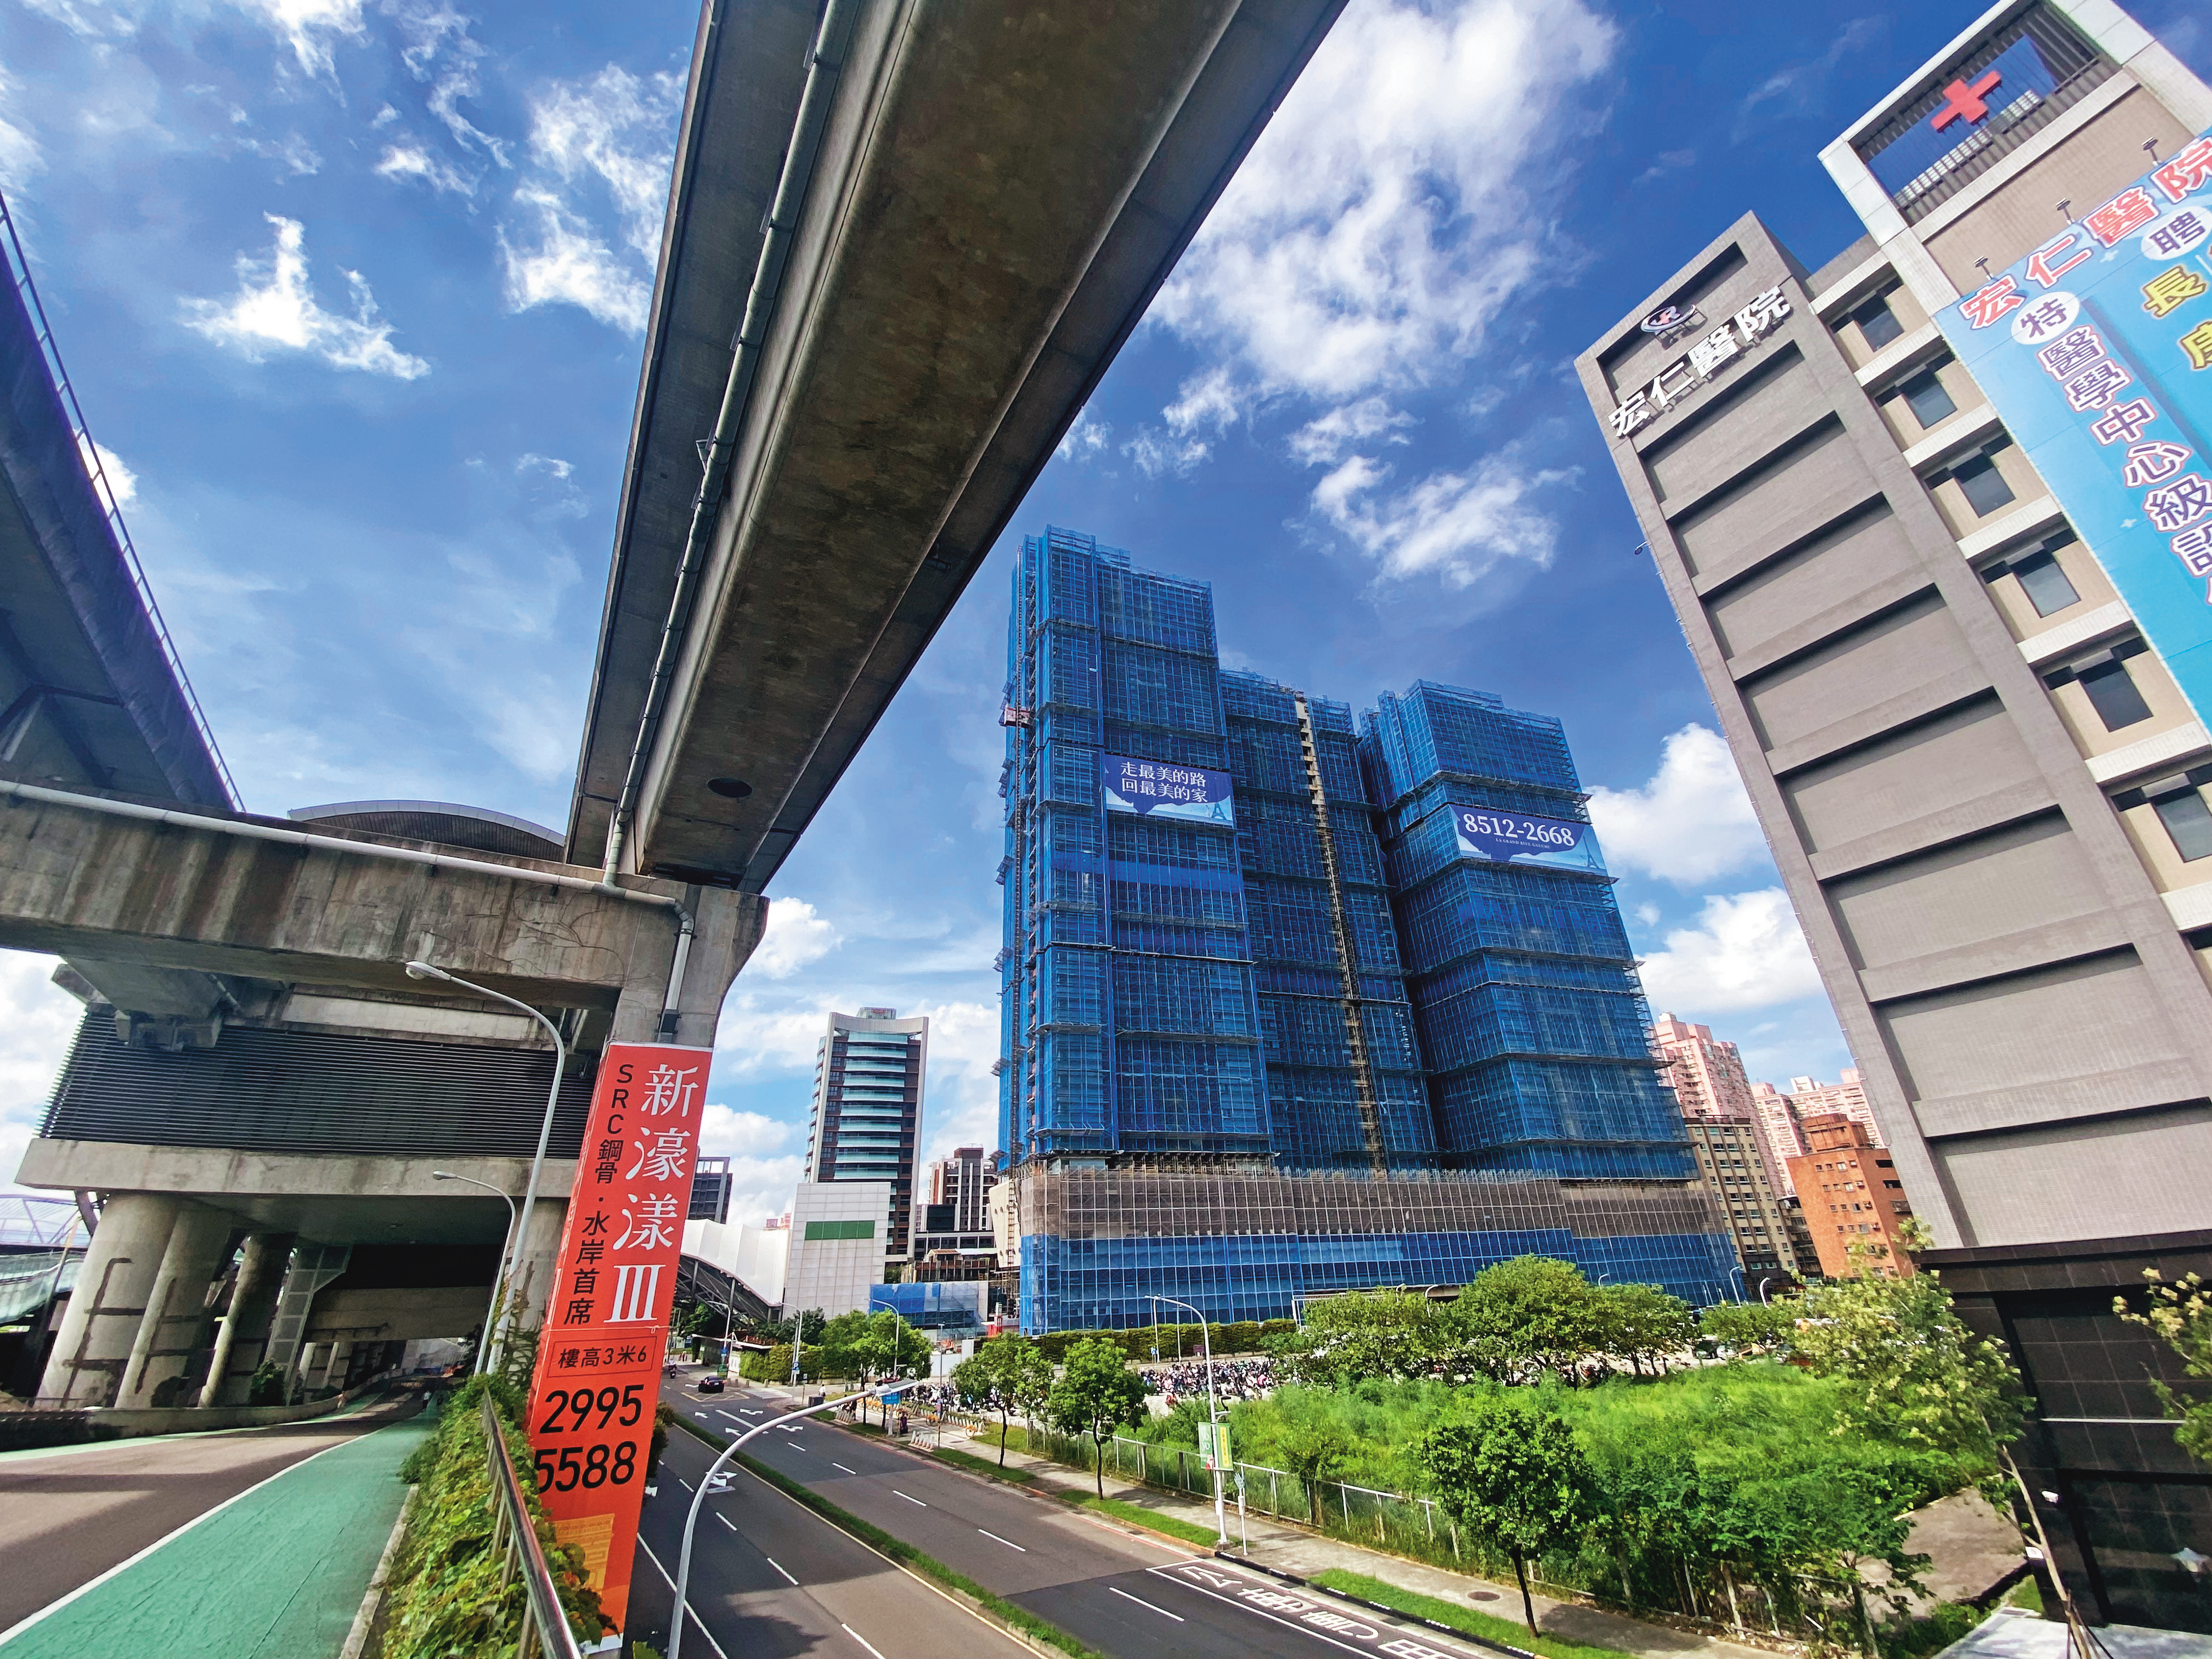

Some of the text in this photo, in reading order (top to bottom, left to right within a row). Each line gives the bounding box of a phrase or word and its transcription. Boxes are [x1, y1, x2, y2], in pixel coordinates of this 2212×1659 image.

[1960, 137, 2212, 329] 宏仁醫院
[1608, 285, 1791, 437] 宏仁醫院
[1120, 761, 1206, 788] 走最美的路
[1121, 778, 1208, 803] 回最美的家
[1463, 813, 1575, 847] 8512-2668
[557, 1345, 647, 1369] 樓高3米6
[540, 1384, 645, 1434] 2995
[534, 1441, 637, 1494] 5588
